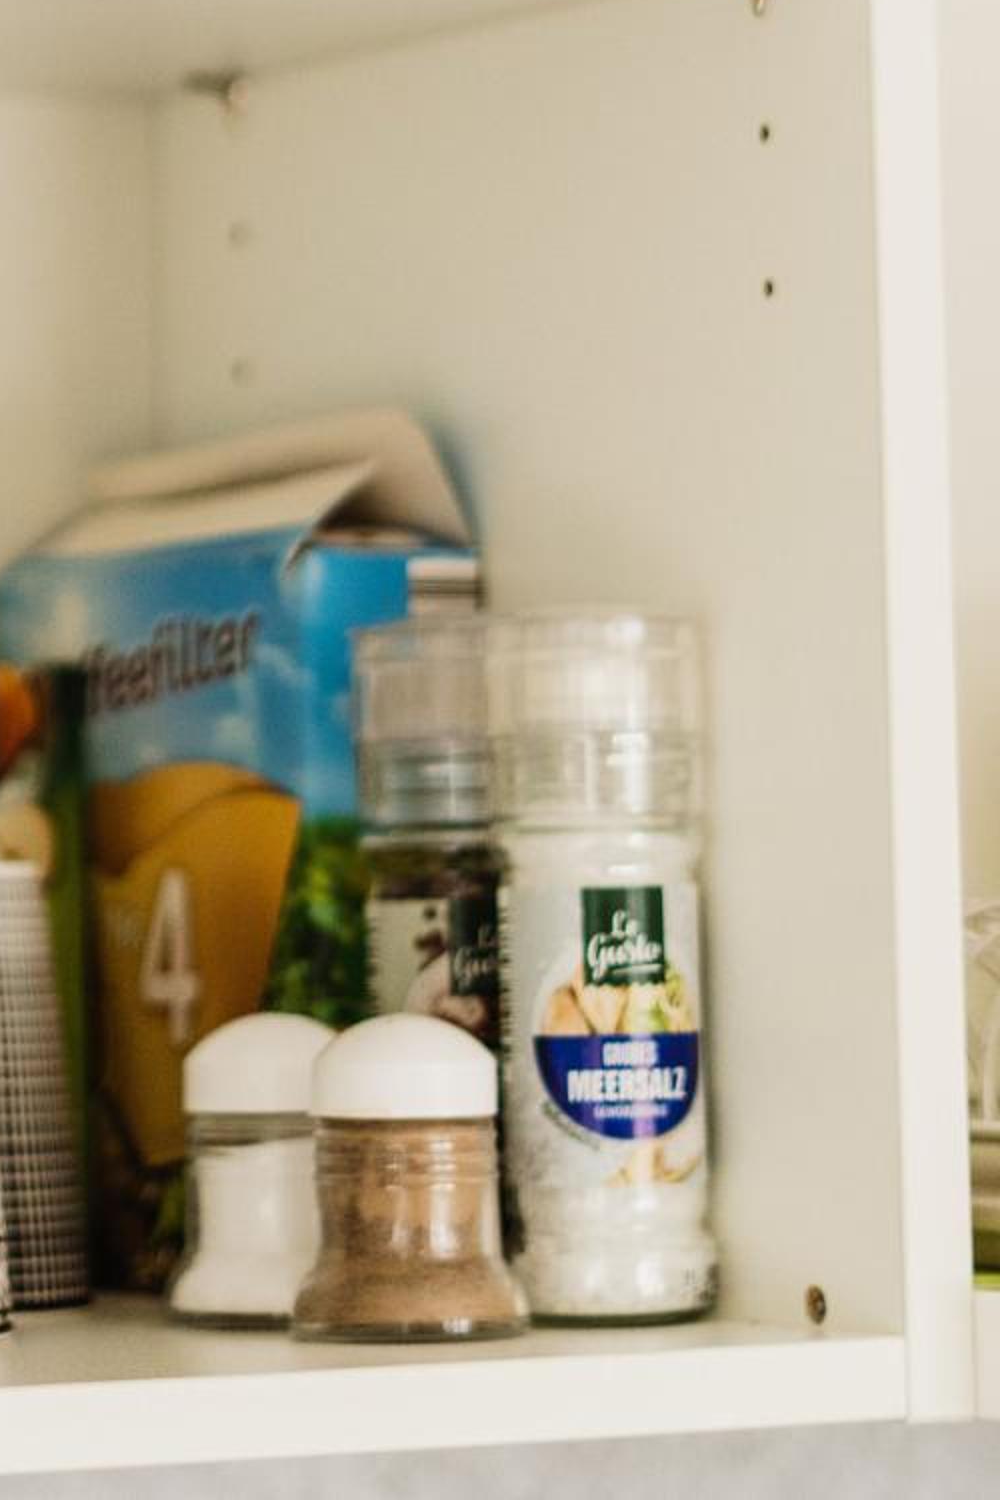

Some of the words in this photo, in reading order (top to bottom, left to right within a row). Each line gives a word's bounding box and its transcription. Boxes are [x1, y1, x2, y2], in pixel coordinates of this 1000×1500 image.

[139, 867, 203, 1044] 4
[587, 933, 662, 979] Gusto
[567, 1067, 688, 1103] MEERSALZ
